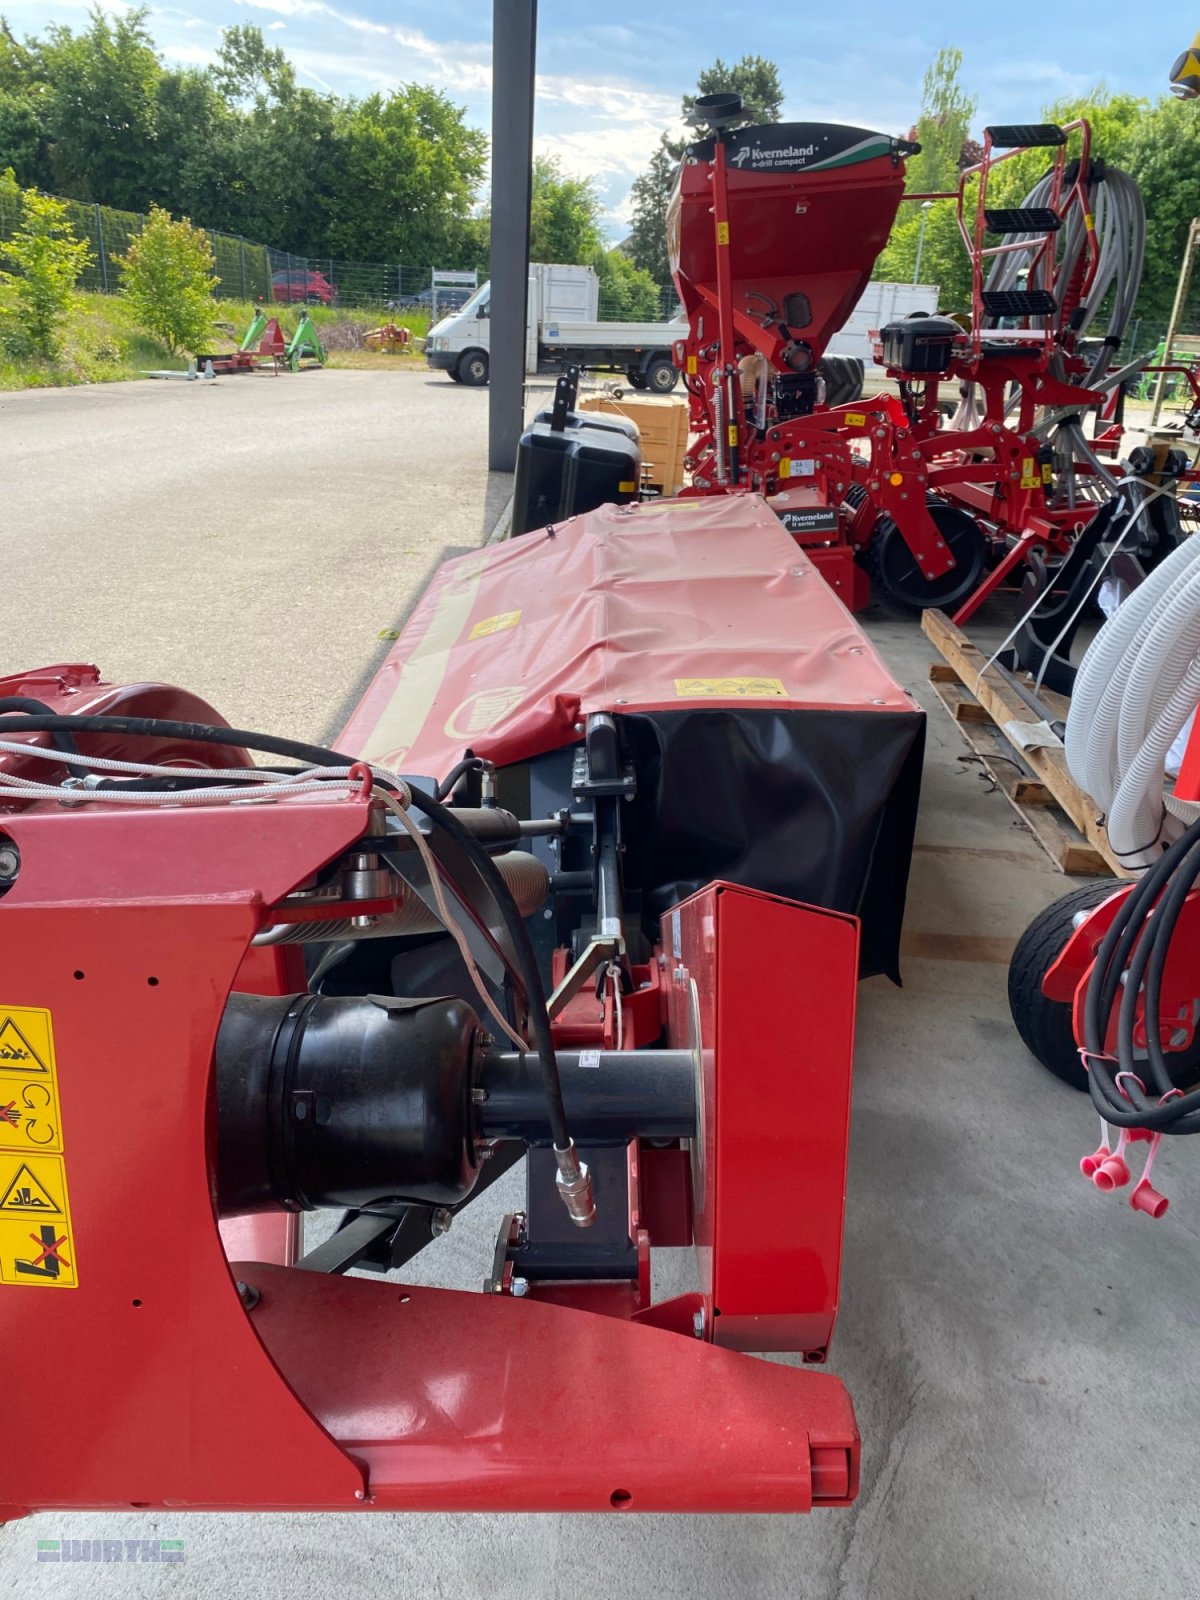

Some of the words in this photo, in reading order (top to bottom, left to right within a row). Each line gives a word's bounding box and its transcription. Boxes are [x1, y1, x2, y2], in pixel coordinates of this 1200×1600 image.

[752, 144, 814, 160] Kverneland
[752, 160, 773, 168] e-drill
[774, 157, 806, 166] compact
[792, 511, 834, 522] Kverneland
